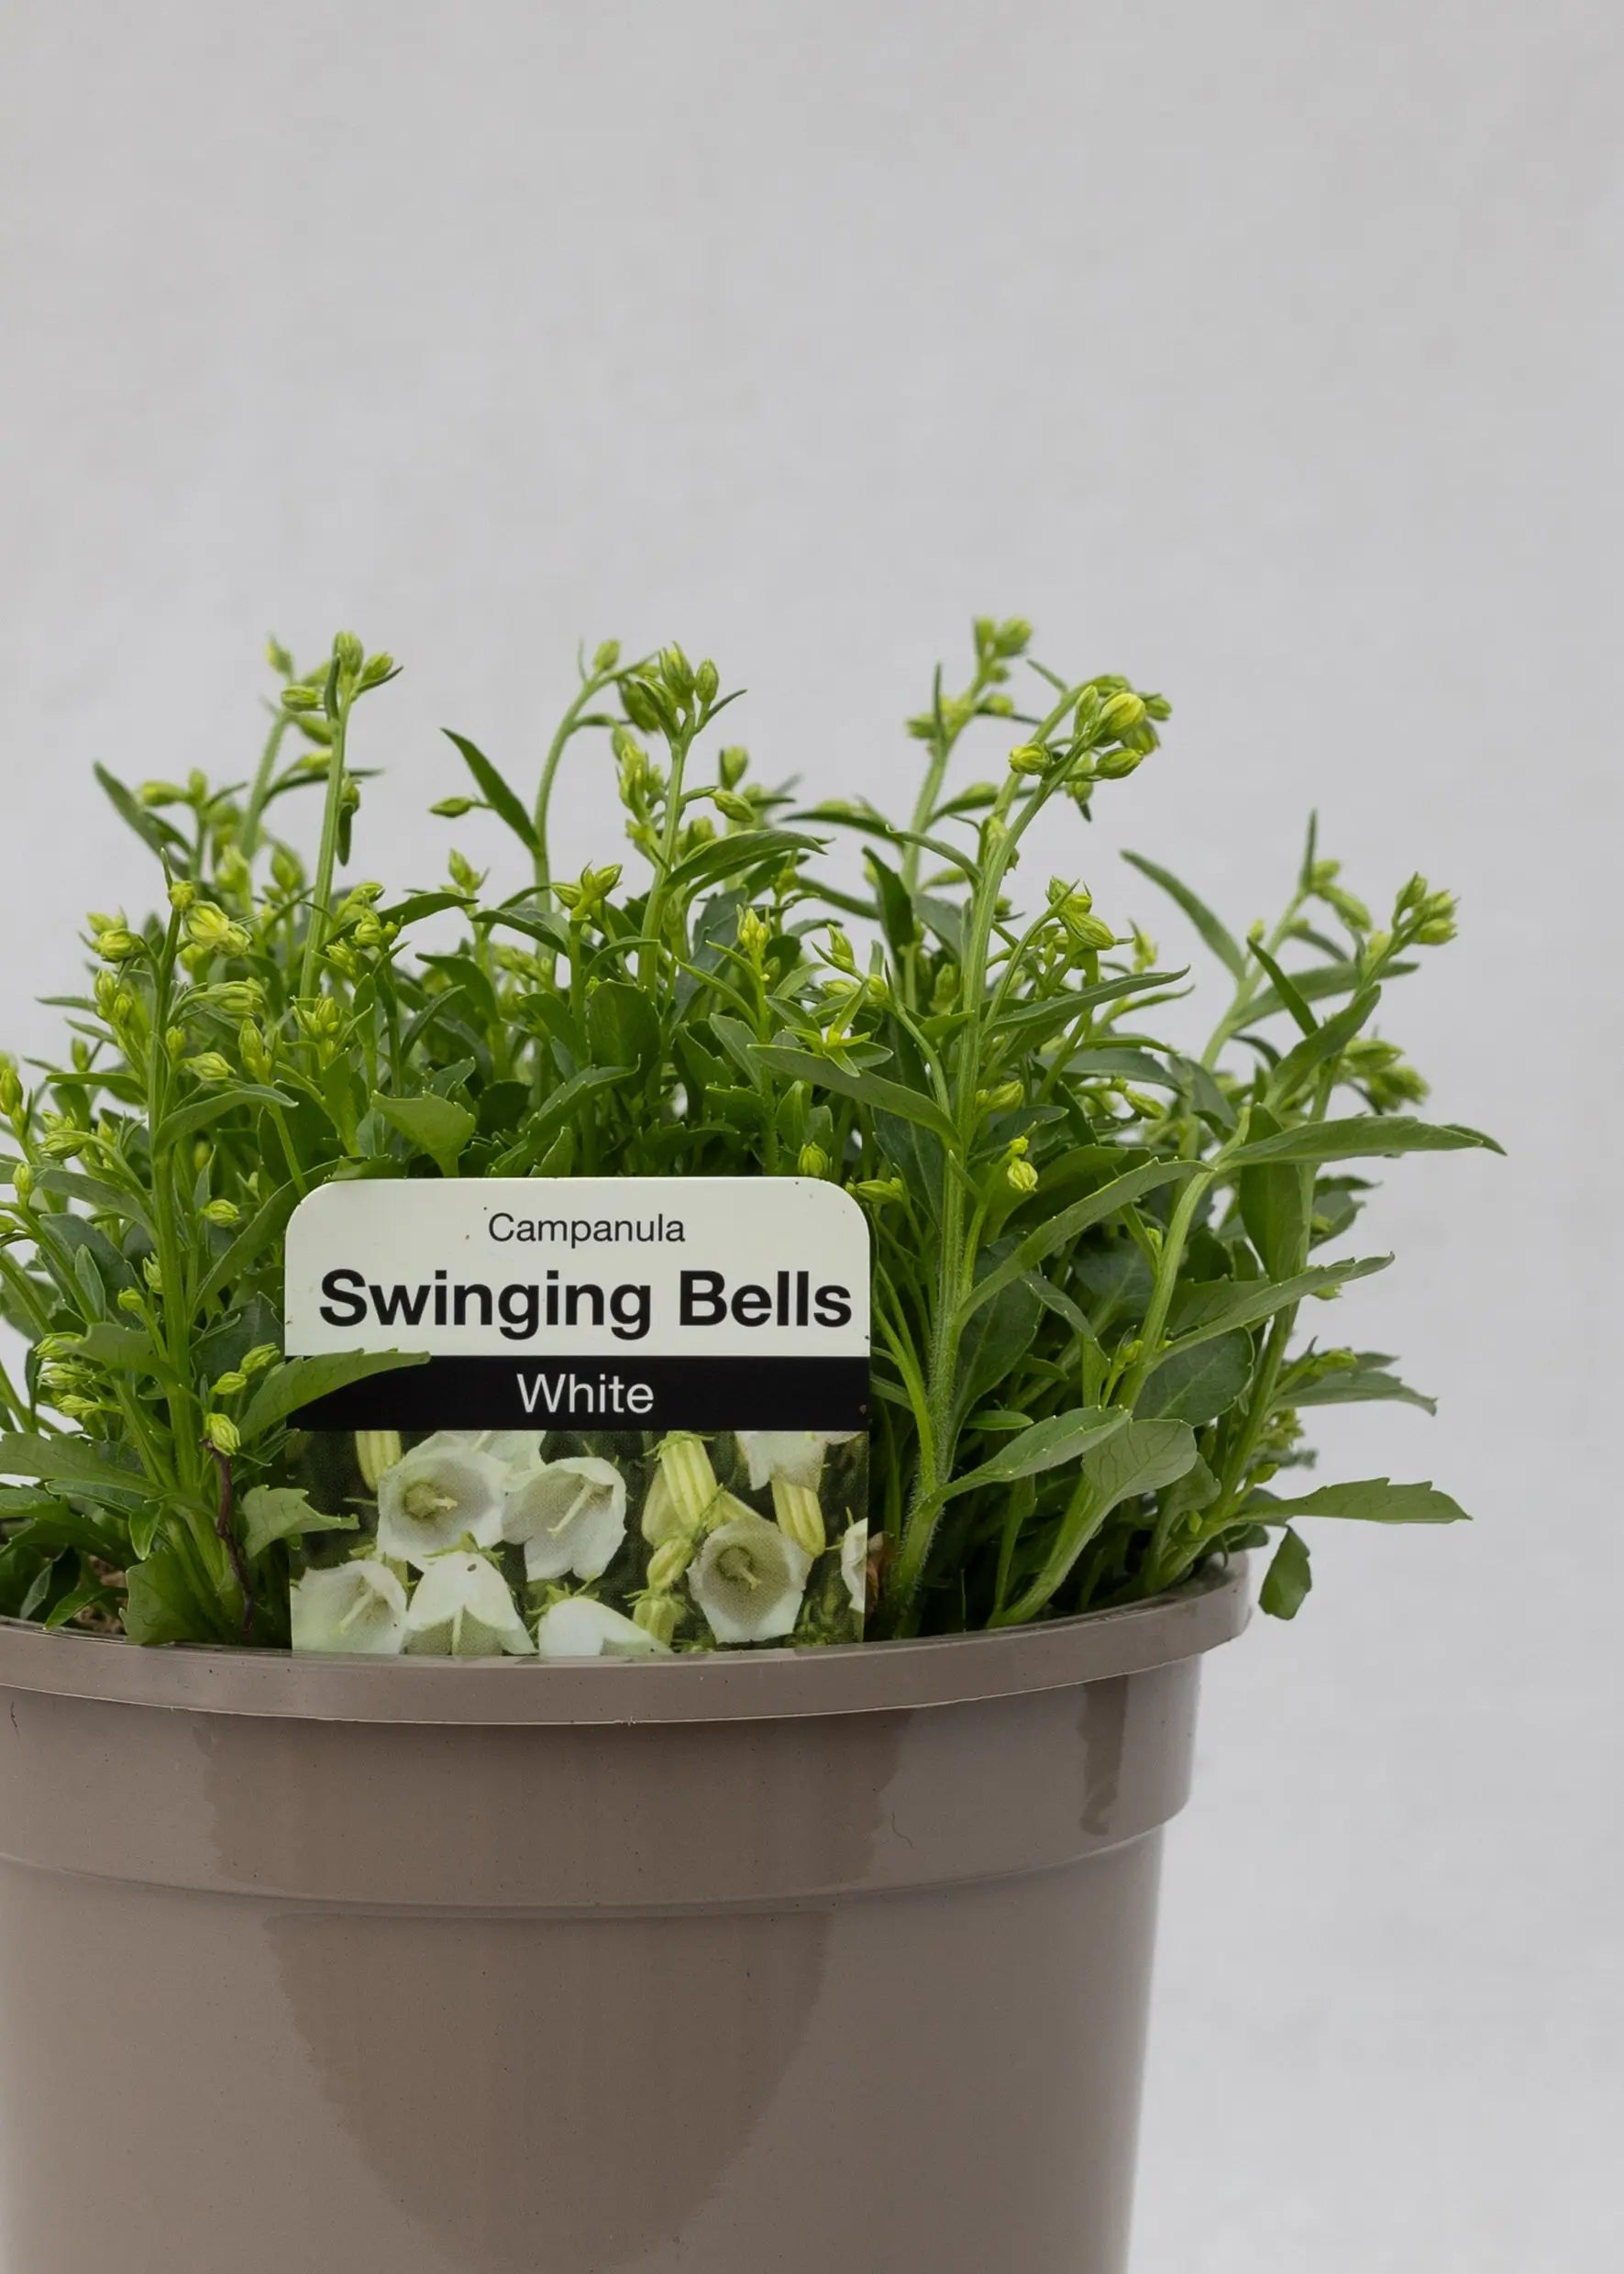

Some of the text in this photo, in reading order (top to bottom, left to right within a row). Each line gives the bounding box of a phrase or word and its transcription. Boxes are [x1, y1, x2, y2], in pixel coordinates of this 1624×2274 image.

[488, 1212, 685, 1249] Campanula
[319, 1268, 853, 1341] Swinging Bells
[516, 1374, 655, 1414] White
